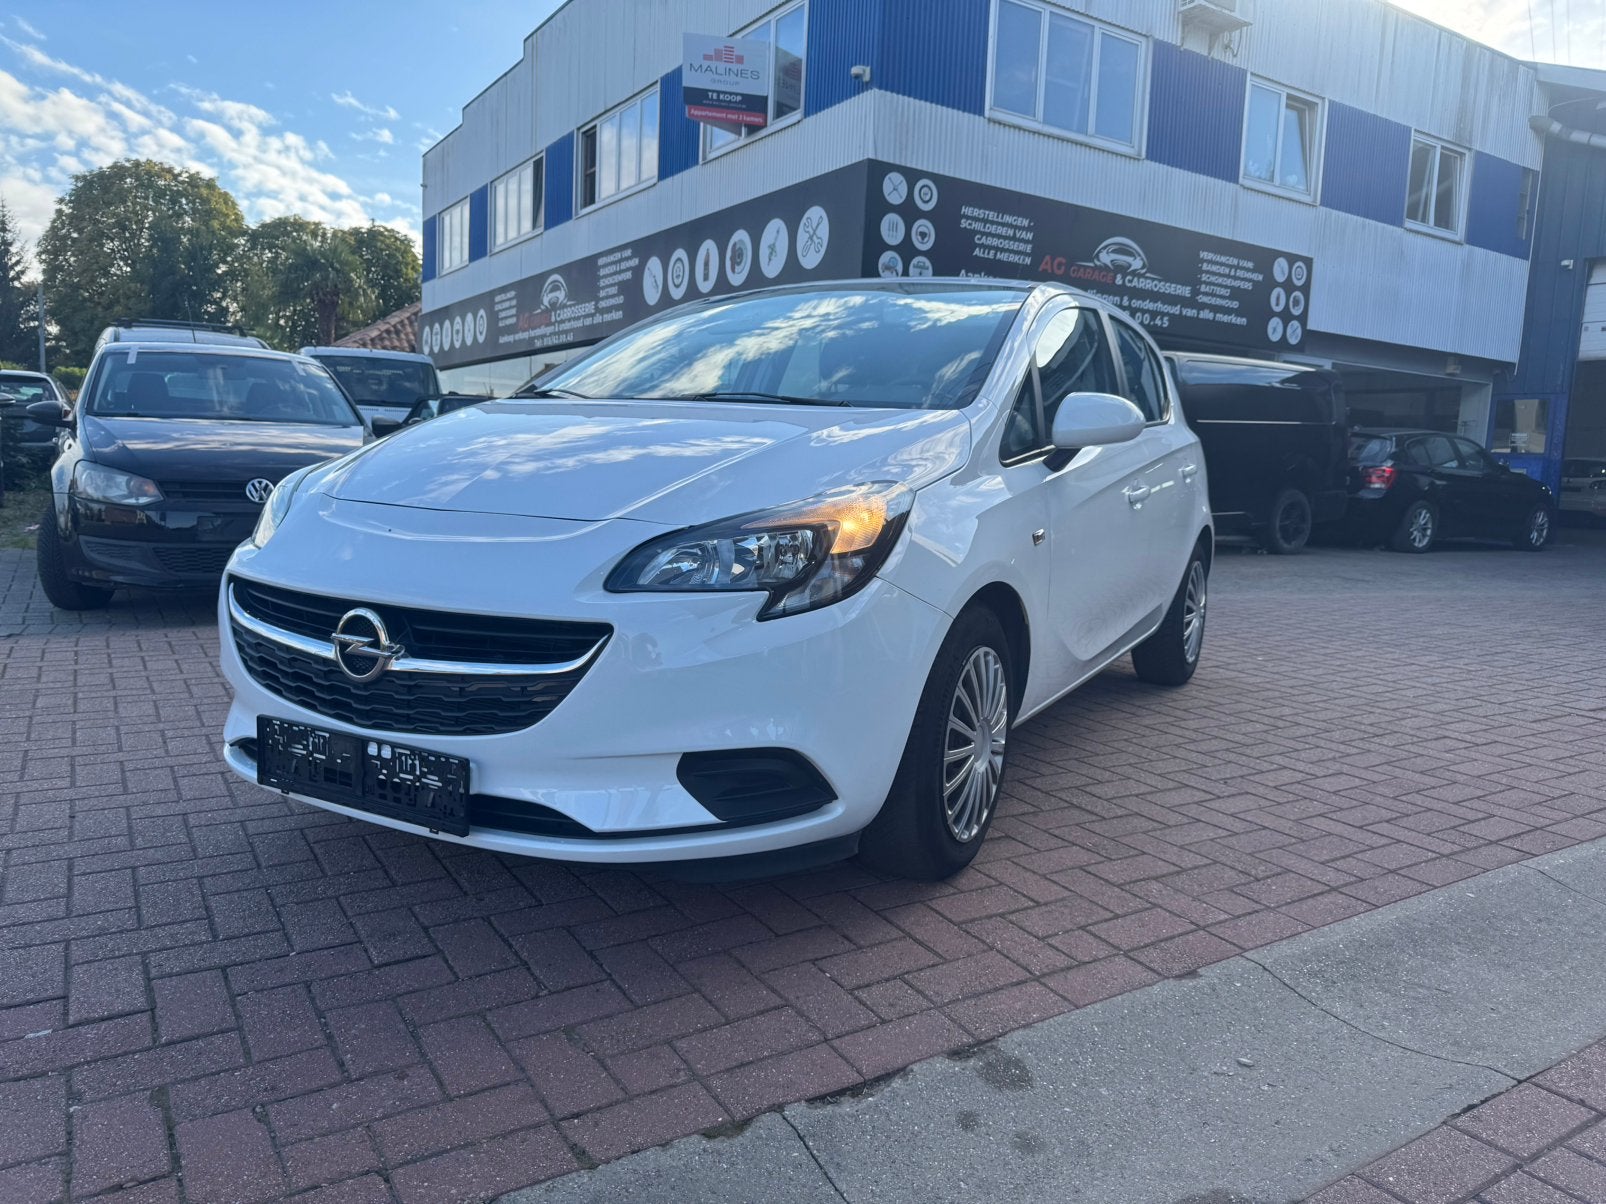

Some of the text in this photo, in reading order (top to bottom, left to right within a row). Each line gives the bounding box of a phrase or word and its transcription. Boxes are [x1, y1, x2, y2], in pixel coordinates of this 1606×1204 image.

[689, 62, 760, 80] MALINES
[710, 77, 740, 86] GROUP
[707, 92, 742, 103] TE KOOP
[961, 205, 1030, 227] HERSTELLINGEN
[960, 219, 1034, 240] SCHILDEREN VAN
[974, 234, 1033, 253] CARROSSERIE
[972, 247, 1032, 265] ALLE MERKEN
[1199, 250, 1239, 266] VERVANGEN
[1038, 254, 1067, 275] AG
[1070, 265, 1114, 283] GARAGE
[1115, 273, 1124, 285] &
[1125, 275, 1192, 297] CARROSSERIE
[1202, 262, 1230, 275] BANDEN
[1121, 295, 1129, 306] &
[1131, 299, 1181, 315] onderhoud
[1181, 307, 1197, 317] van
[1198, 309, 1214, 320] alle
[1215, 313, 1247, 326] merken
